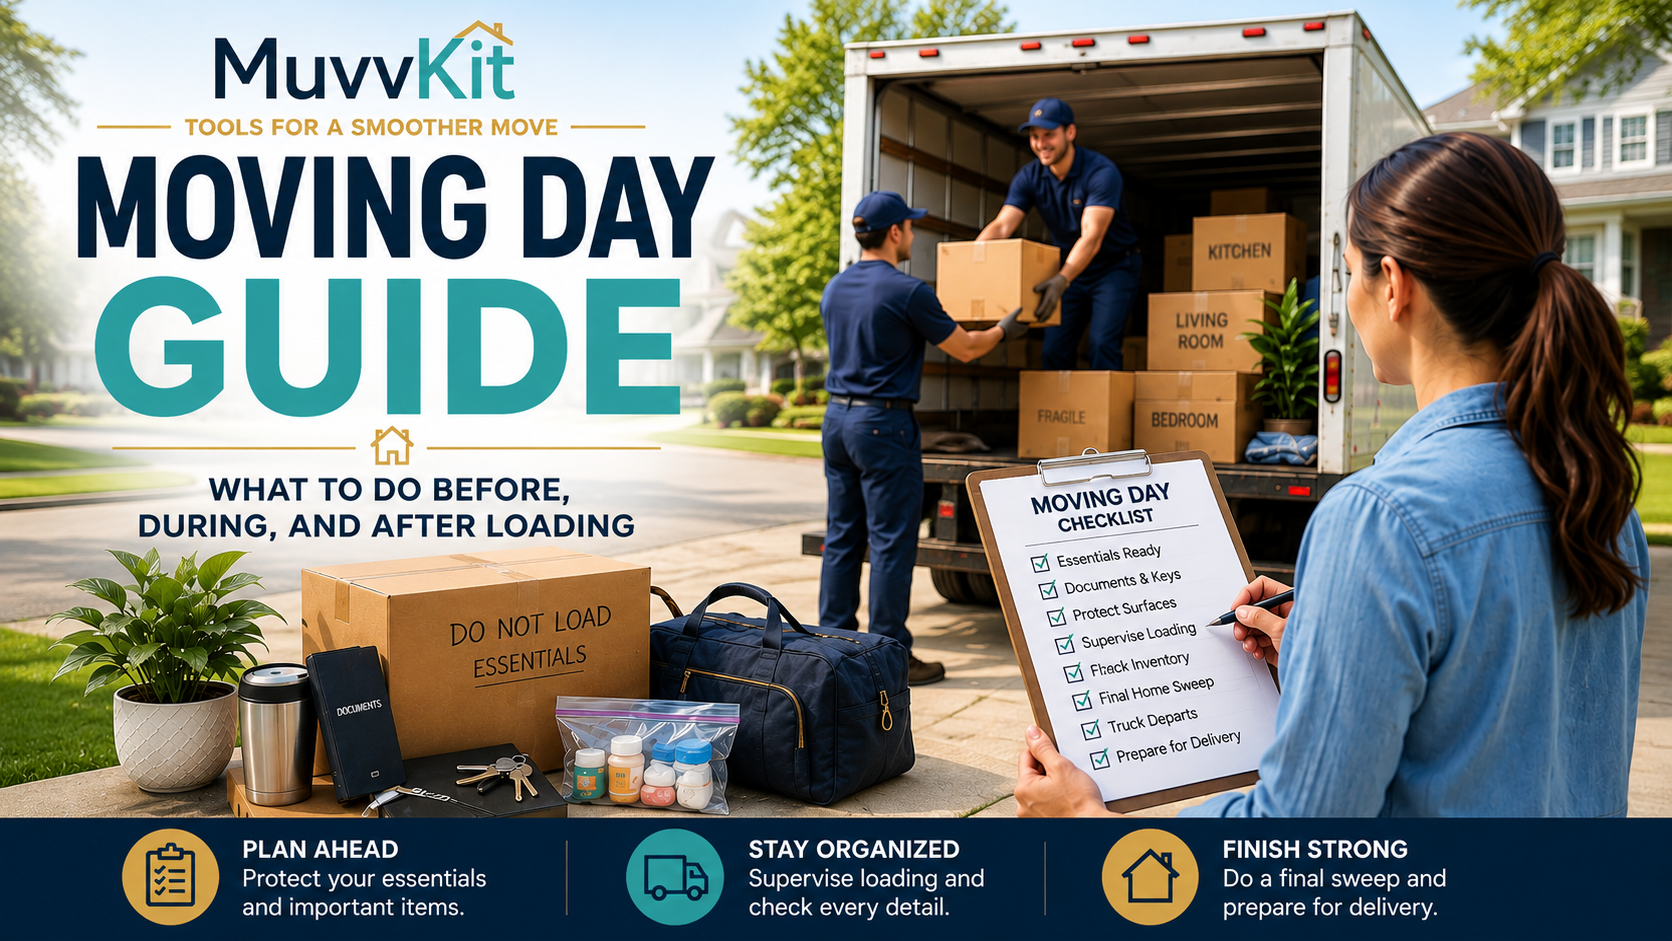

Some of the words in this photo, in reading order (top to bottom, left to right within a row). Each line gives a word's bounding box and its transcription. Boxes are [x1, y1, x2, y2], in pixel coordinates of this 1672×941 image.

[1208, 242, 1272, 261] KITCHEN
[1176, 312, 1228, 329] LIVING
[1178, 333, 1224, 350] ROOM
[1037, 409, 1086, 425] FRAGILE
[1151, 412, 1219, 429] BEDROOM
[1030, 487, 1124, 515] MOVING
[1128, 482, 1170, 504] DAY
[1057, 508, 1154, 533] CHECKLIST
[1056, 549, 1121, 569] Essentials
[1123, 544, 1162, 559] Ready
[1064, 574, 1137, 595] Documents
[1139, 572, 1150, 585] &
[1152, 568, 1182, 584] Keys
[1072, 604, 1121, 622] Protect
[1121, 596, 1177, 615] Surfaces
[450, 620, 486, 648] DO
[497, 612, 546, 640] NOT
[554, 605, 613, 631] LOAD
[1081, 629, 1145, 650] Supervise
[1146, 622, 1198, 638] Loading
[473, 644, 588, 680] ESSENTIALS
[1130, 652, 1190, 672] Inventory
[1099, 689, 1130, 705] Final
[1132, 681, 1171, 699] Home
[1172, 676, 1215, 693] Sweep
[336, 699, 383, 717] DOCUMENTS
[1107, 717, 1145, 734] Truck
[1147, 707, 1199, 728] Departs
[1116, 743, 1168, 765] Prepare
[1169, 739, 1188, 753] for
[1190, 729, 1242, 749] Delivery
